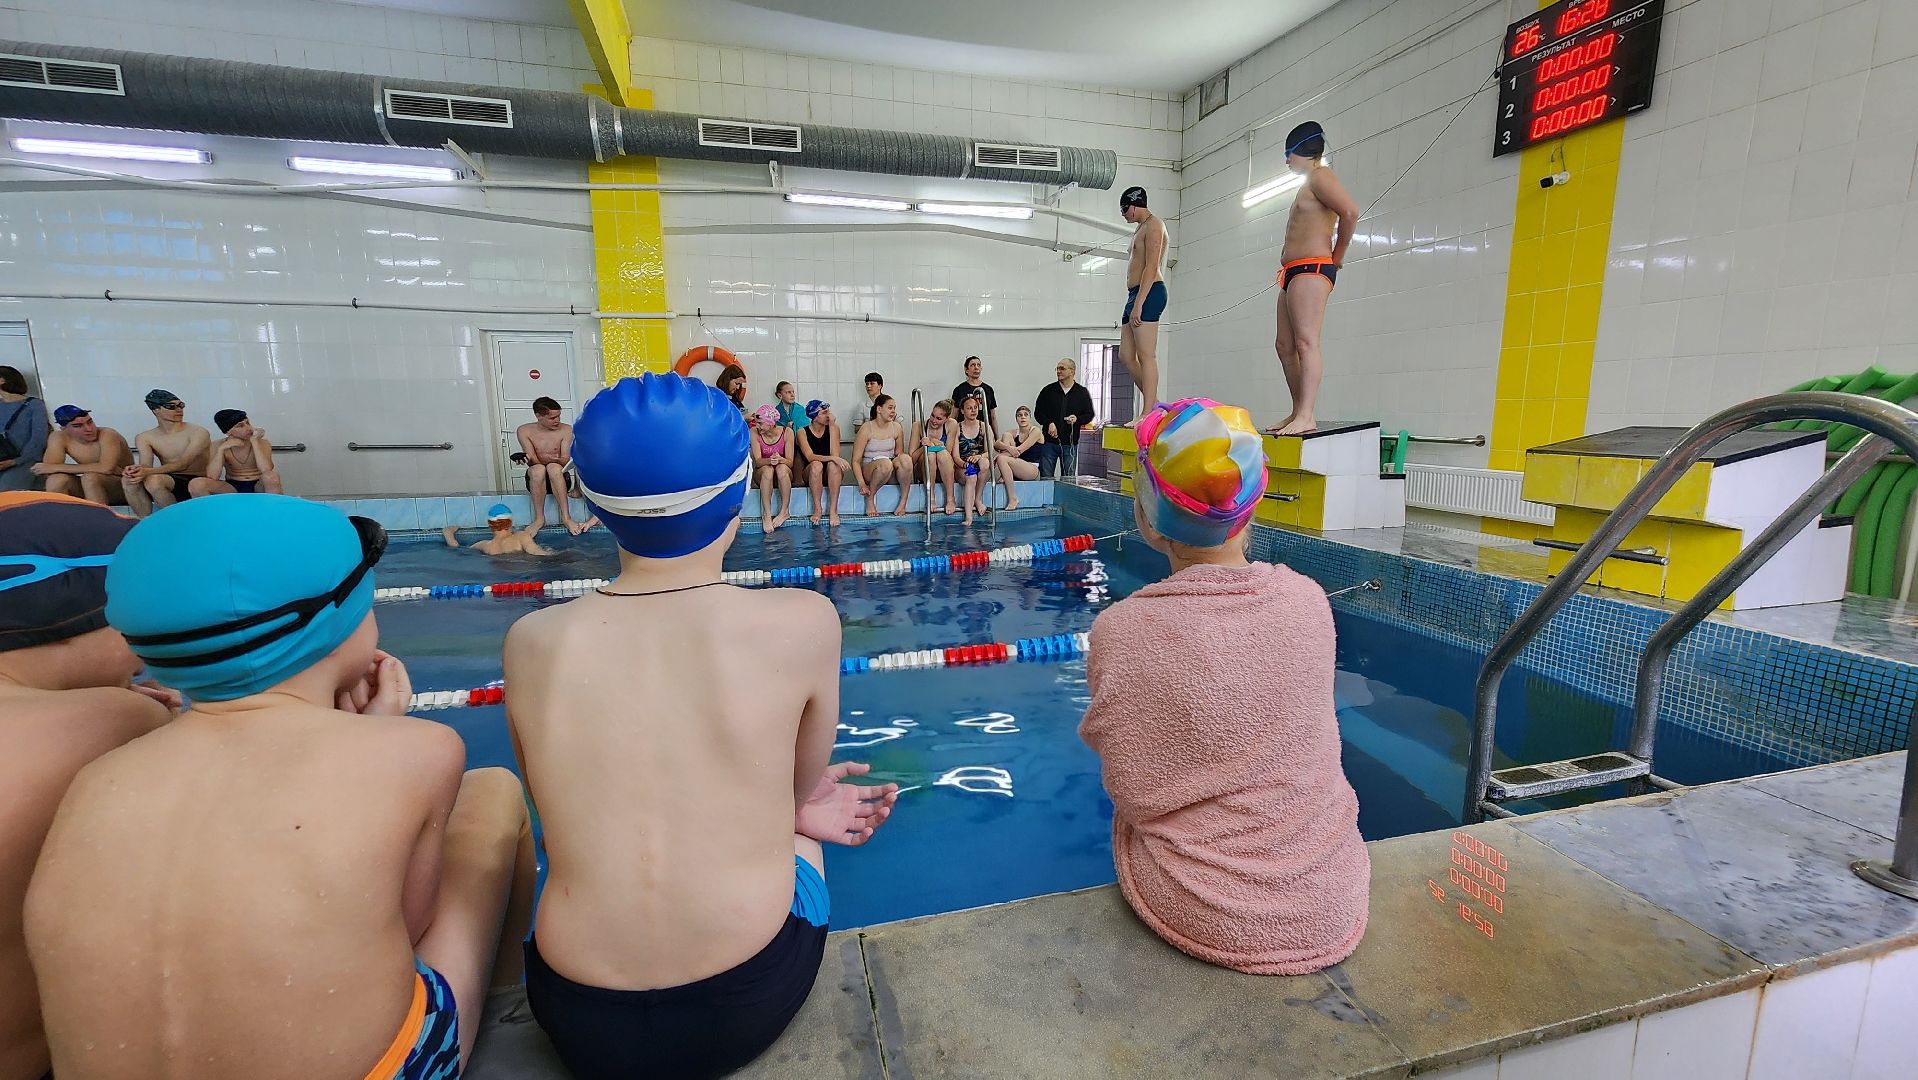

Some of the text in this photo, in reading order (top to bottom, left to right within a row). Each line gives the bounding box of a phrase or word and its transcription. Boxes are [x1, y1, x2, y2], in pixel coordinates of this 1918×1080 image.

[1509, 33, 1616, 91] 1 0:00.00
[1514, 25, 1540, 54] 26
[1531, 8, 1646, 63] РЕЗУЛЬТАТ МЕСТО
[1504, 64, 1612, 119] 2 0:00.00
[1501, 94, 1608, 146] 3 0:00.00
